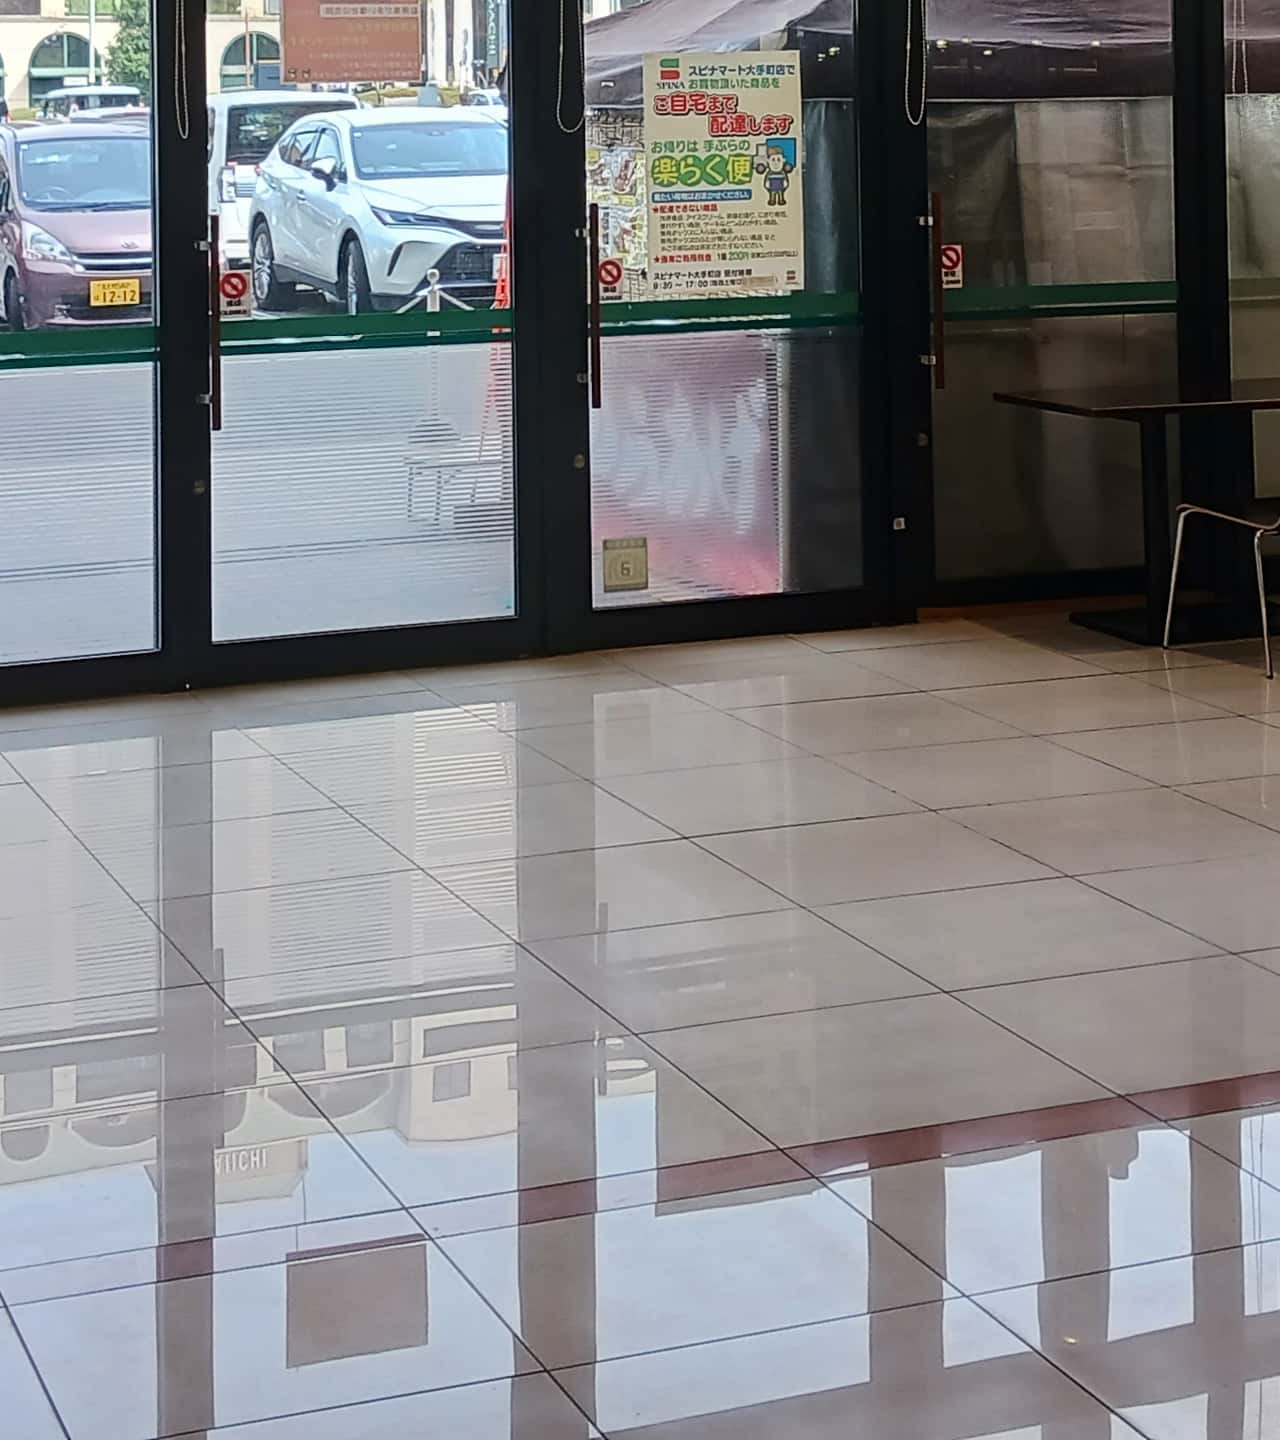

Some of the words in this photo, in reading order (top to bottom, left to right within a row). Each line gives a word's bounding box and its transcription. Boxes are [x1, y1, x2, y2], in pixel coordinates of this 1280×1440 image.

[654, 92, 738, 114] ご自宅まで
[709, 113, 794, 136] 配達します
[653, 154, 753, 185] 楽らく便
